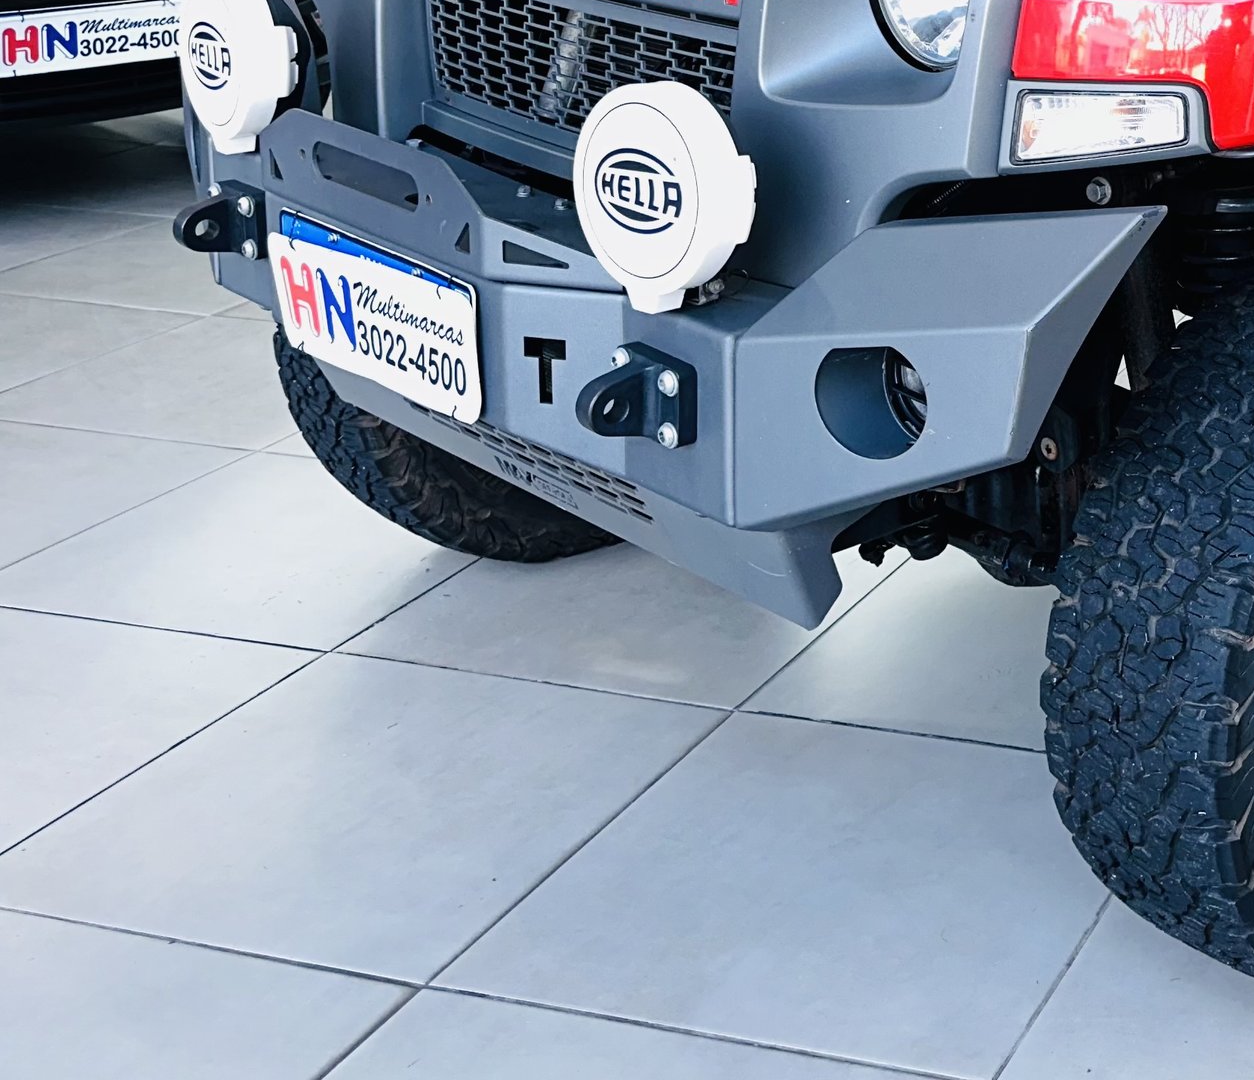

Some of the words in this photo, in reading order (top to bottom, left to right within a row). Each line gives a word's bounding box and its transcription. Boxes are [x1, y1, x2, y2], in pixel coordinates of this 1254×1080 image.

[2, 21, 79, 67] HN
[191, 41, 232, 77] HELLA
[601, 172, 683, 218] HELLA
[280, 255, 357, 352] HN
[353, 281, 464, 347] Multimarcas
[357, 320, 467, 396] 3022-4500
